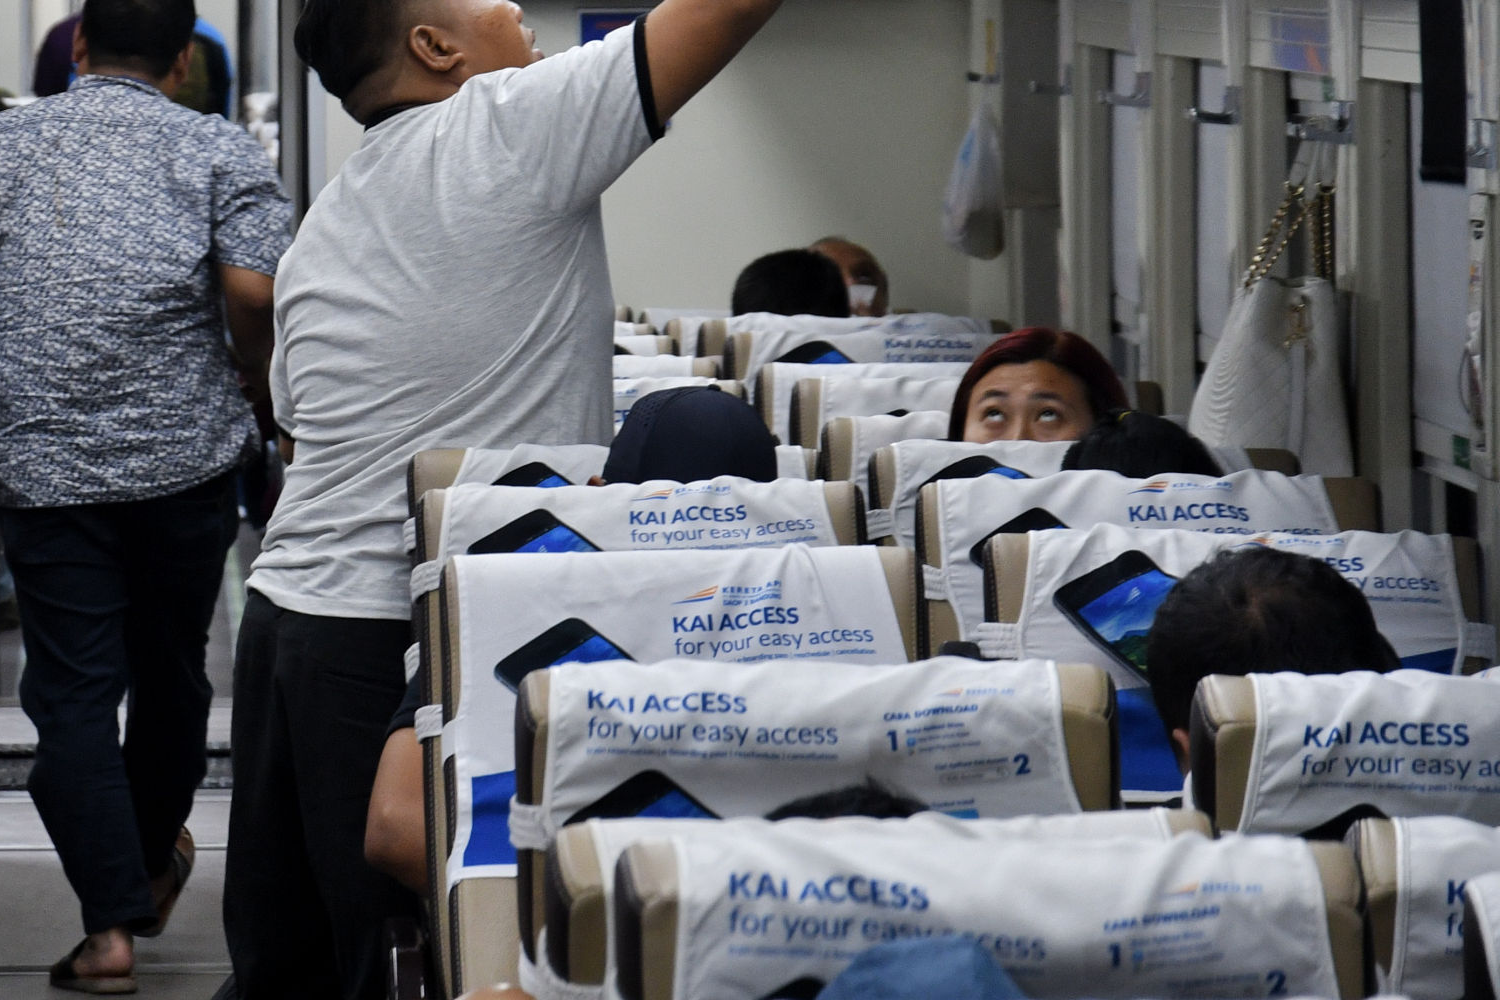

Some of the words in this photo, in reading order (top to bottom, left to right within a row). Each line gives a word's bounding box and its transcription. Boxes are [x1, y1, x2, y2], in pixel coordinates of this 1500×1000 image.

[629, 510, 666, 526] KAI
[672, 504, 747, 524] ACCESS
[1129, 504, 1168, 522] KAI
[1173, 502, 1250, 522] ACCESS
[630, 528, 657, 543] for
[663, 529, 705, 545] your
[709, 527, 751, 540] easy
[756, 518, 816, 537] access
[1374, 576, 1440, 592] access
[673, 614, 714, 633] KAI
[719, 606, 799, 631] ACCESS
[675, 637, 705, 655] for
[710, 637, 753, 658] your
[759, 632, 803, 649] easy
[809, 628, 874, 645] access
[587, 690, 635, 714] KAI
[642, 691, 748, 715] ACCESS
[587, 716, 622, 740] for
[629, 724, 686, 745] your
[692, 726, 750, 747] easy
[756, 726, 838, 746] access
[887, 730, 898, 751] 1
[1303, 722, 1351, 748] KAI
[1359, 721, 1470, 747] ACCESS
[1013, 753, 1031, 776] 2
[1302, 754, 1338, 776] for
[1345, 756, 1405, 777] your
[1411, 757, 1472, 780] easy
[729, 872, 788, 900] KAI
[799, 874, 930, 912] ACCESS
[728, 904, 774, 935] for
[783, 914, 854, 942] your
[1109, 943, 1121, 968] 1
[1267, 969, 1288, 996] 2
